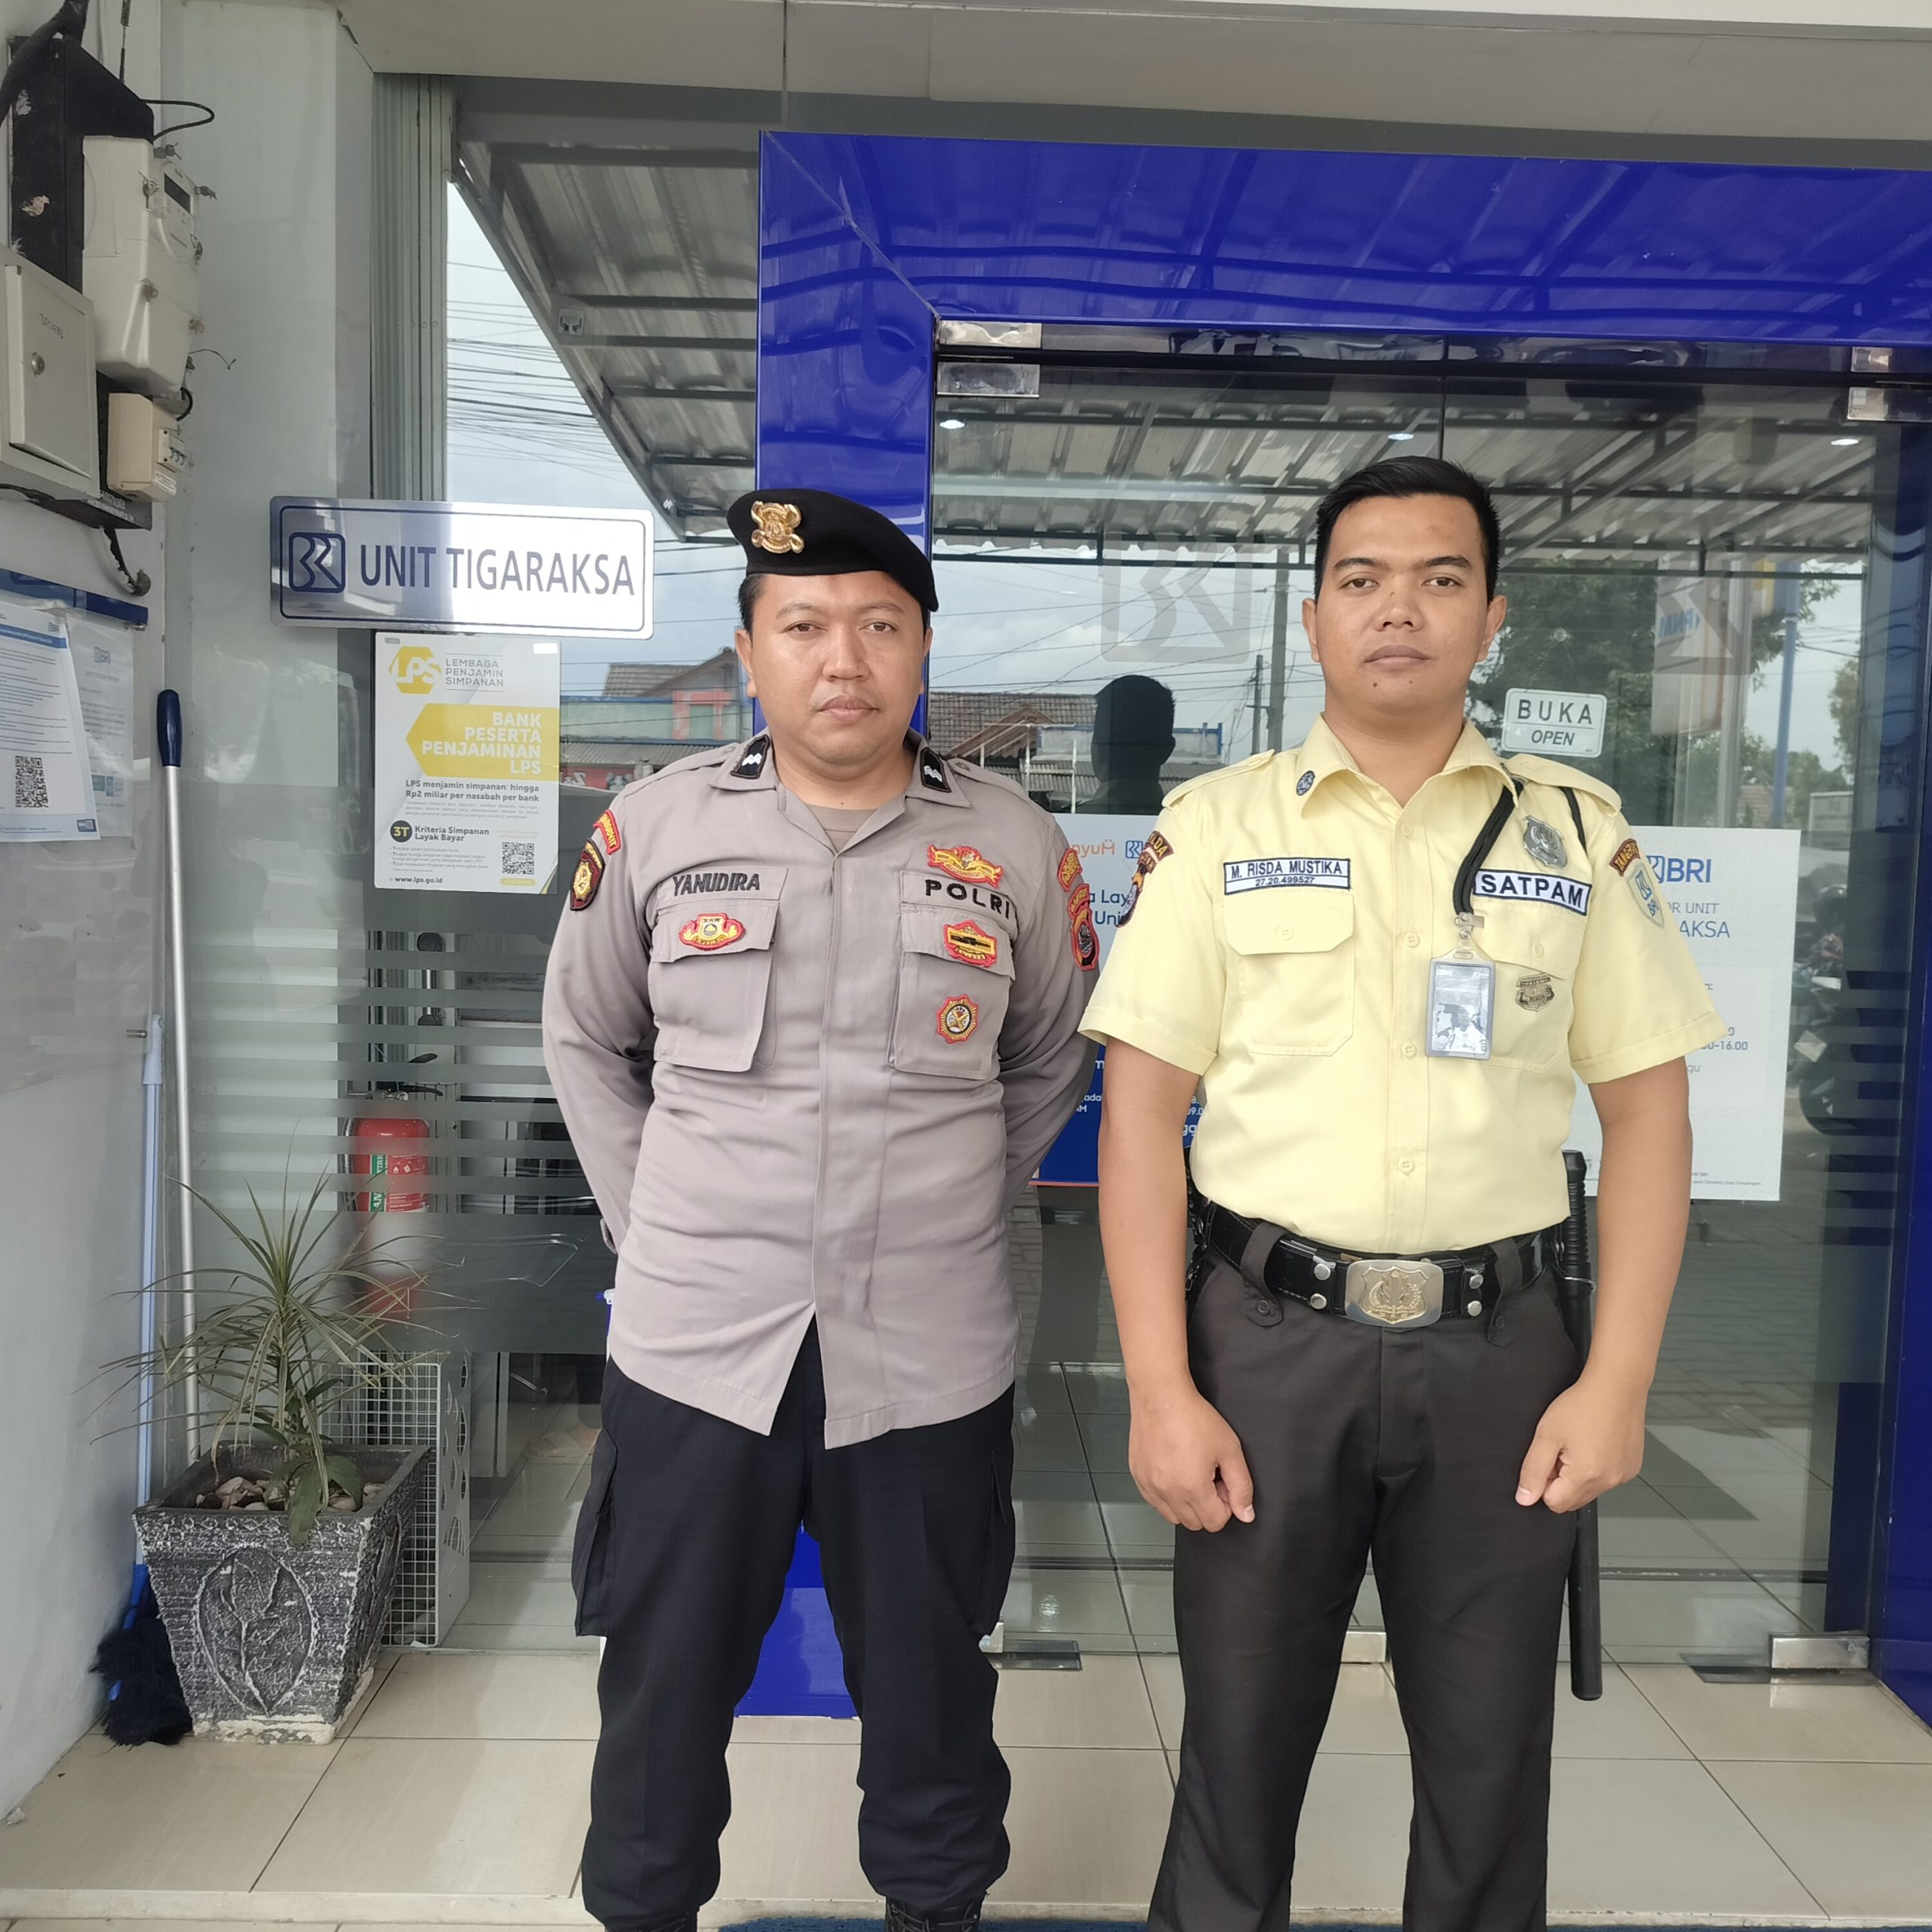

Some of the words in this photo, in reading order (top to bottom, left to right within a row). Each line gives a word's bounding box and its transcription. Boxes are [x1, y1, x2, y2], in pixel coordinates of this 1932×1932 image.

[360, 543, 437, 588] UNIT
[445, 547, 635, 596] TIGARAKSA
[445, 658, 500, 669] LEMBAGA
[445, 668, 503, 678] PENJAMIN
[445, 677, 504, 687] SIMPANAN
[492, 711, 542, 728] BANK
[1517, 698, 1593, 725] BUKA
[464, 726, 542, 743] PESERTA
[1531, 729, 1576, 746] OPEN
[421, 740, 541, 759] PENJAMINAN
[510, 759, 541, 775] LPS
[405, 780, 421, 788] LPS
[423, 781, 464, 789] menjamin
[510, 783, 540, 793] hingga
[405, 790, 422, 798] Rp2
[424, 790, 448, 798] miliar
[466, 792, 501, 801] nasabah
[518, 794, 540, 802] bank
[393, 826, 410, 837] 3T
[414, 825, 447, 834] Kriteria
[448, 826, 490, 836] Simpanan
[414, 833, 439, 841] Layak
[441, 835, 465, 843] Bayar
[1231, 865, 1243, 880] M.
[1247, 860, 1284, 878] RISDA
[1288, 860, 1343, 875] MUSTIKA
[1666, 857, 1712, 883] BRI
[395, 876, 443, 884] www.lps.go.id
[672, 872, 760, 897] YANUDIRA
[924, 878, 1010, 919] POLRI
[1481, 873, 1584, 908] SATPAM
[1685, 902, 1720, 914] UNIT
